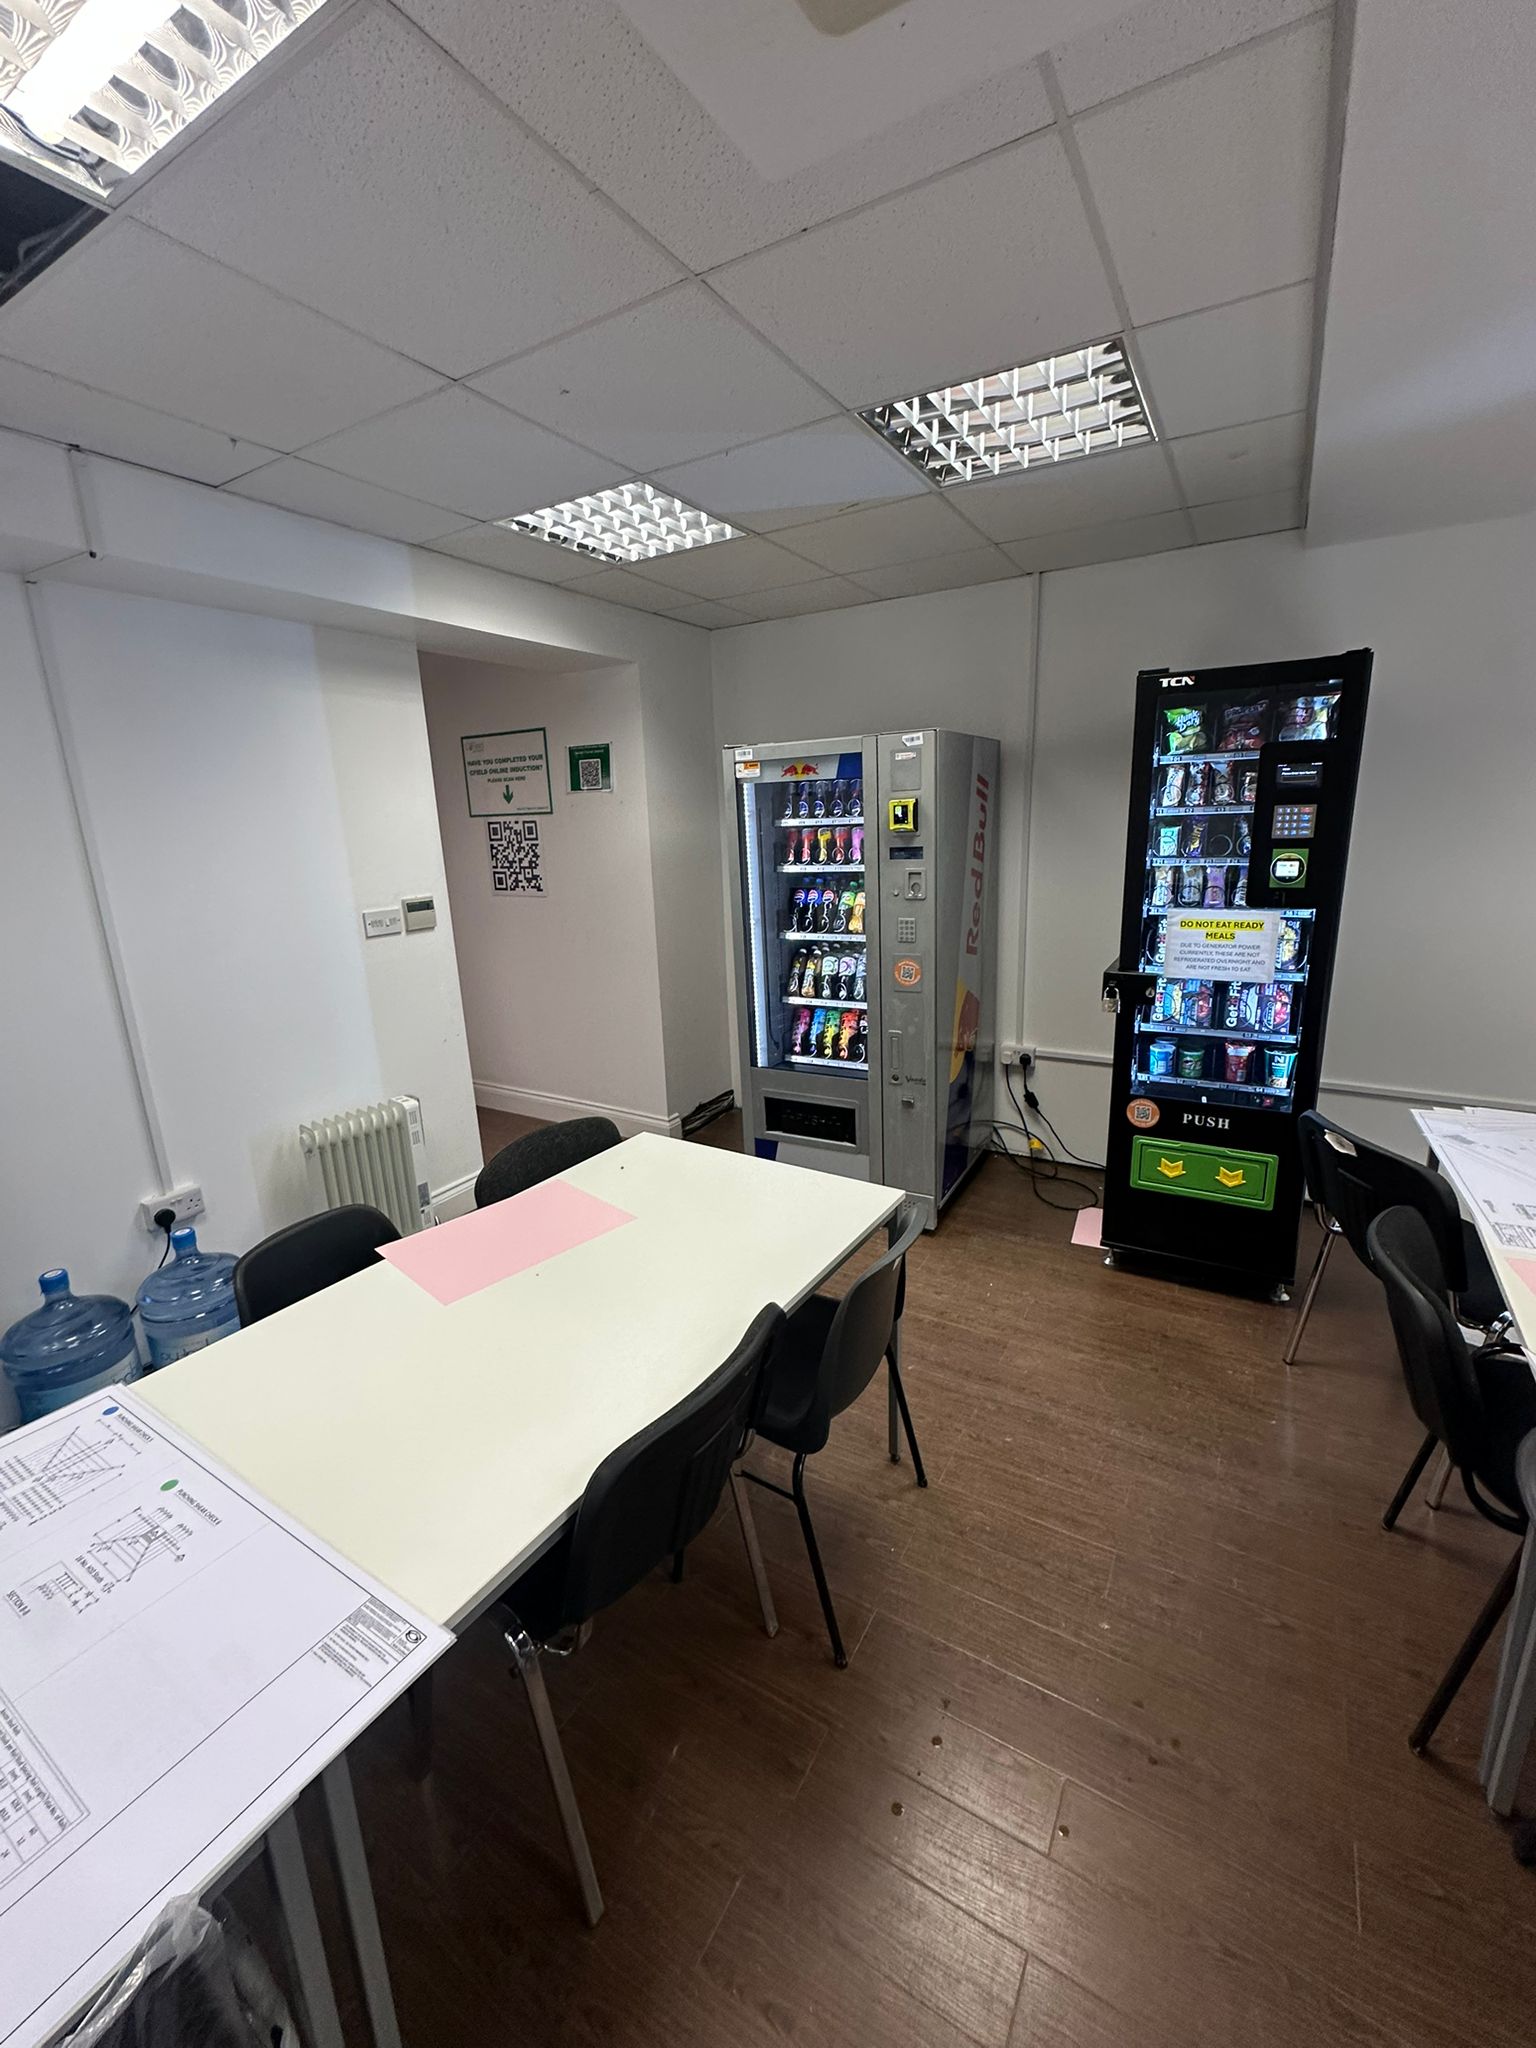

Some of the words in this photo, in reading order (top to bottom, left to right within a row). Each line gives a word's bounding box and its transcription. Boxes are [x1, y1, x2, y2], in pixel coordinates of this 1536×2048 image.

[1159, 676, 1195, 688] TCN
[494, 755, 527, 764] COMPLETED
[488, 767, 508, 775] ONLINE
[973, 773, 990, 864] Bull
[966, 868, 983, 956] Red
[1180, 920, 1193, 928] DO
[1234, 921, 1264, 929] READY
[1205, 932, 1236, 940] MEALS
[1173, 956, 1215, 964] REFRIGERATED
[1157, 978, 1167, 993] Fit
[1230, 981, 1242, 997] Fit
[1153, 1001, 1164, 1022] Get
[1226, 1005, 1239, 1027] Get
[1182, 1113, 1230, 1129] PUSH
